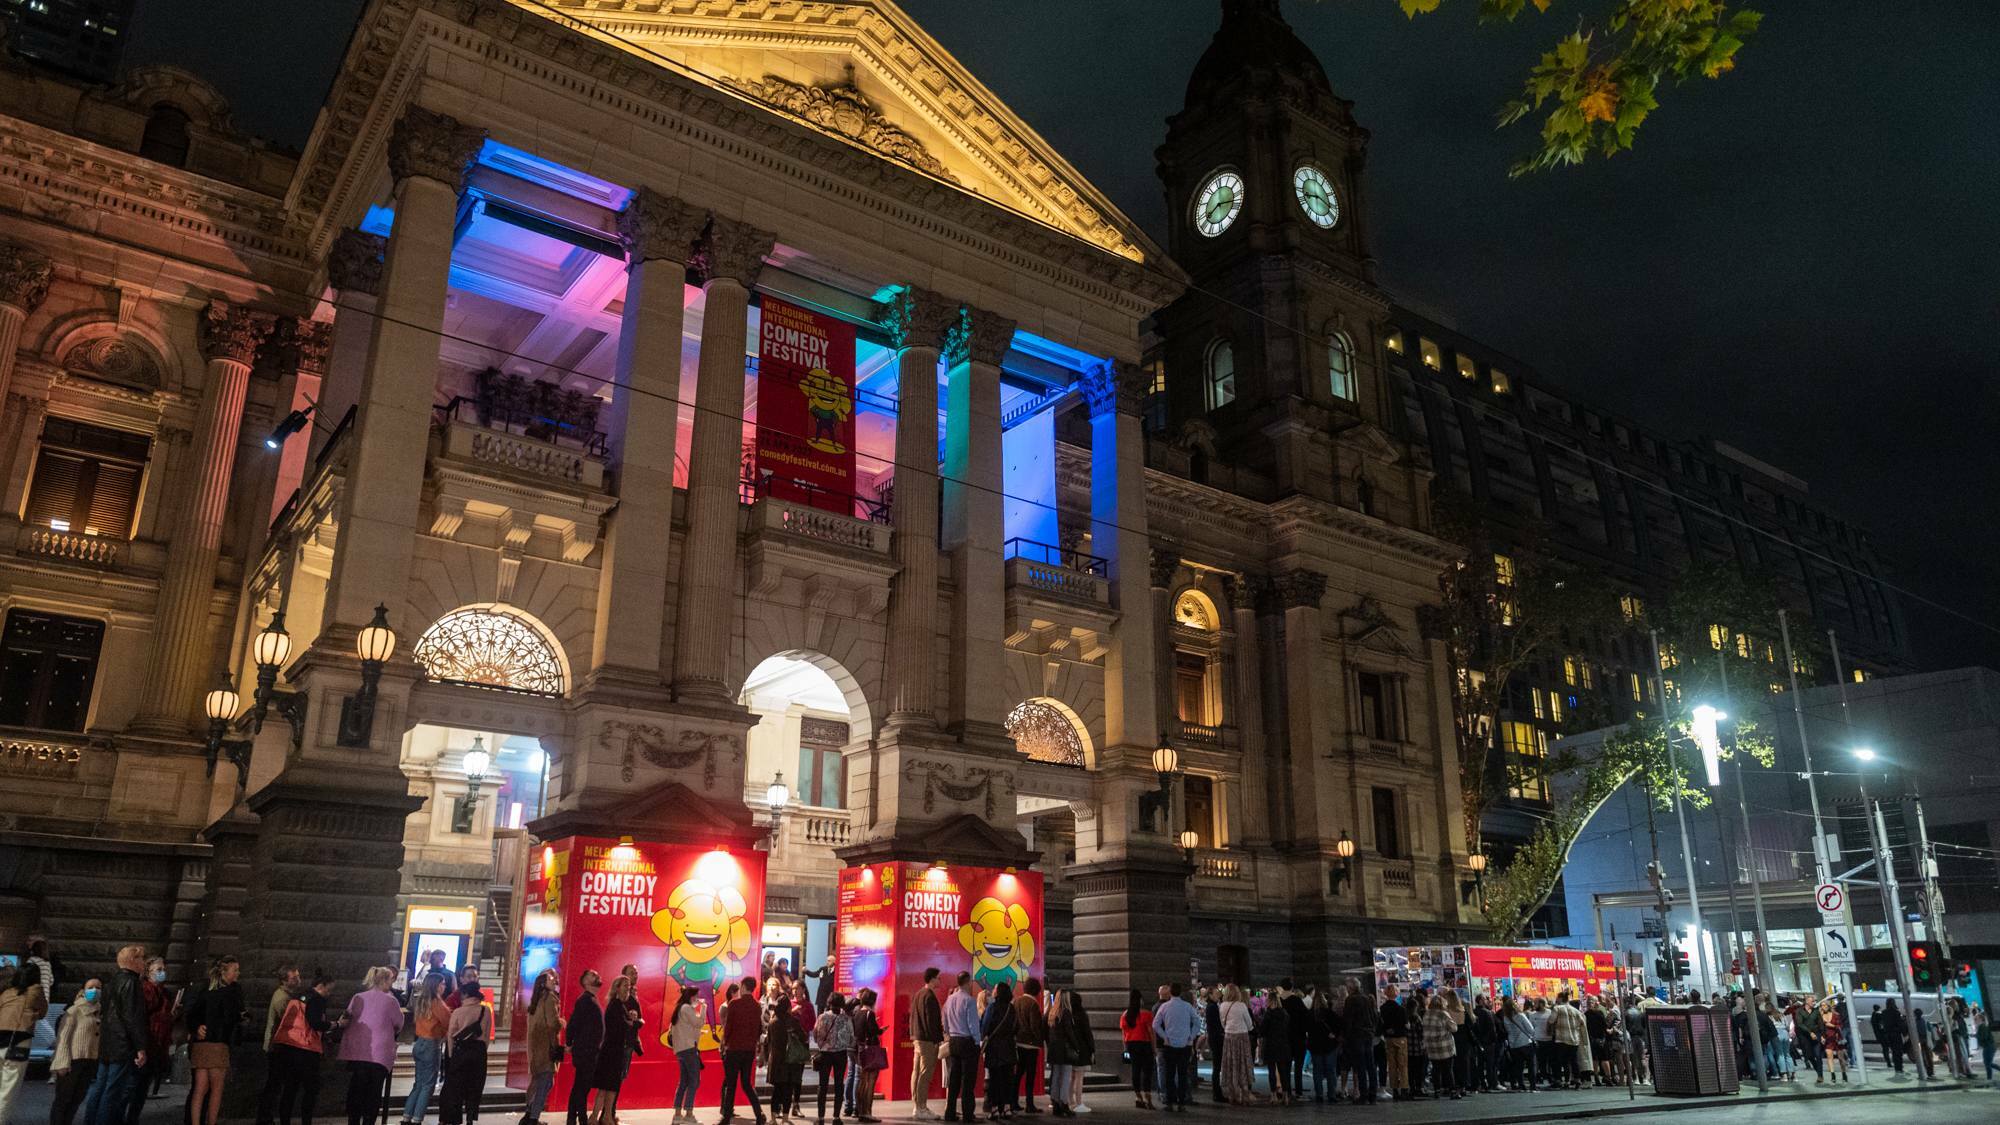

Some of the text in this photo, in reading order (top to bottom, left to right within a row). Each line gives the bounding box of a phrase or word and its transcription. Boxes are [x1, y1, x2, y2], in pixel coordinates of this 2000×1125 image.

[764, 300, 815, 325] MELBOURNE
[764, 311, 828, 339] INTERNATIONAL
[763, 321, 829, 356] COMEDY
[763, 339, 830, 373] FESTIVAL
[759, 448, 847, 478] comedyfestival.com.au
[584, 845, 642, 860] MELBONE
[583, 858, 657, 874] INTERNATIONAL
[905, 868, 949, 881] MELBOE
[581, 871, 658, 896] COMEDY
[905, 879, 960, 893] INTERNATIONAL
[579, 894, 656, 917] FESTIVAL
[904, 891, 961, 912] COMEDY
[904, 911, 961, 930] FESTIVAL
[1531, 957, 1556, 970] COMEDY
[1557, 958, 1585, 971] FESTIVAL
[1829, 951, 1849, 959] ONLY
